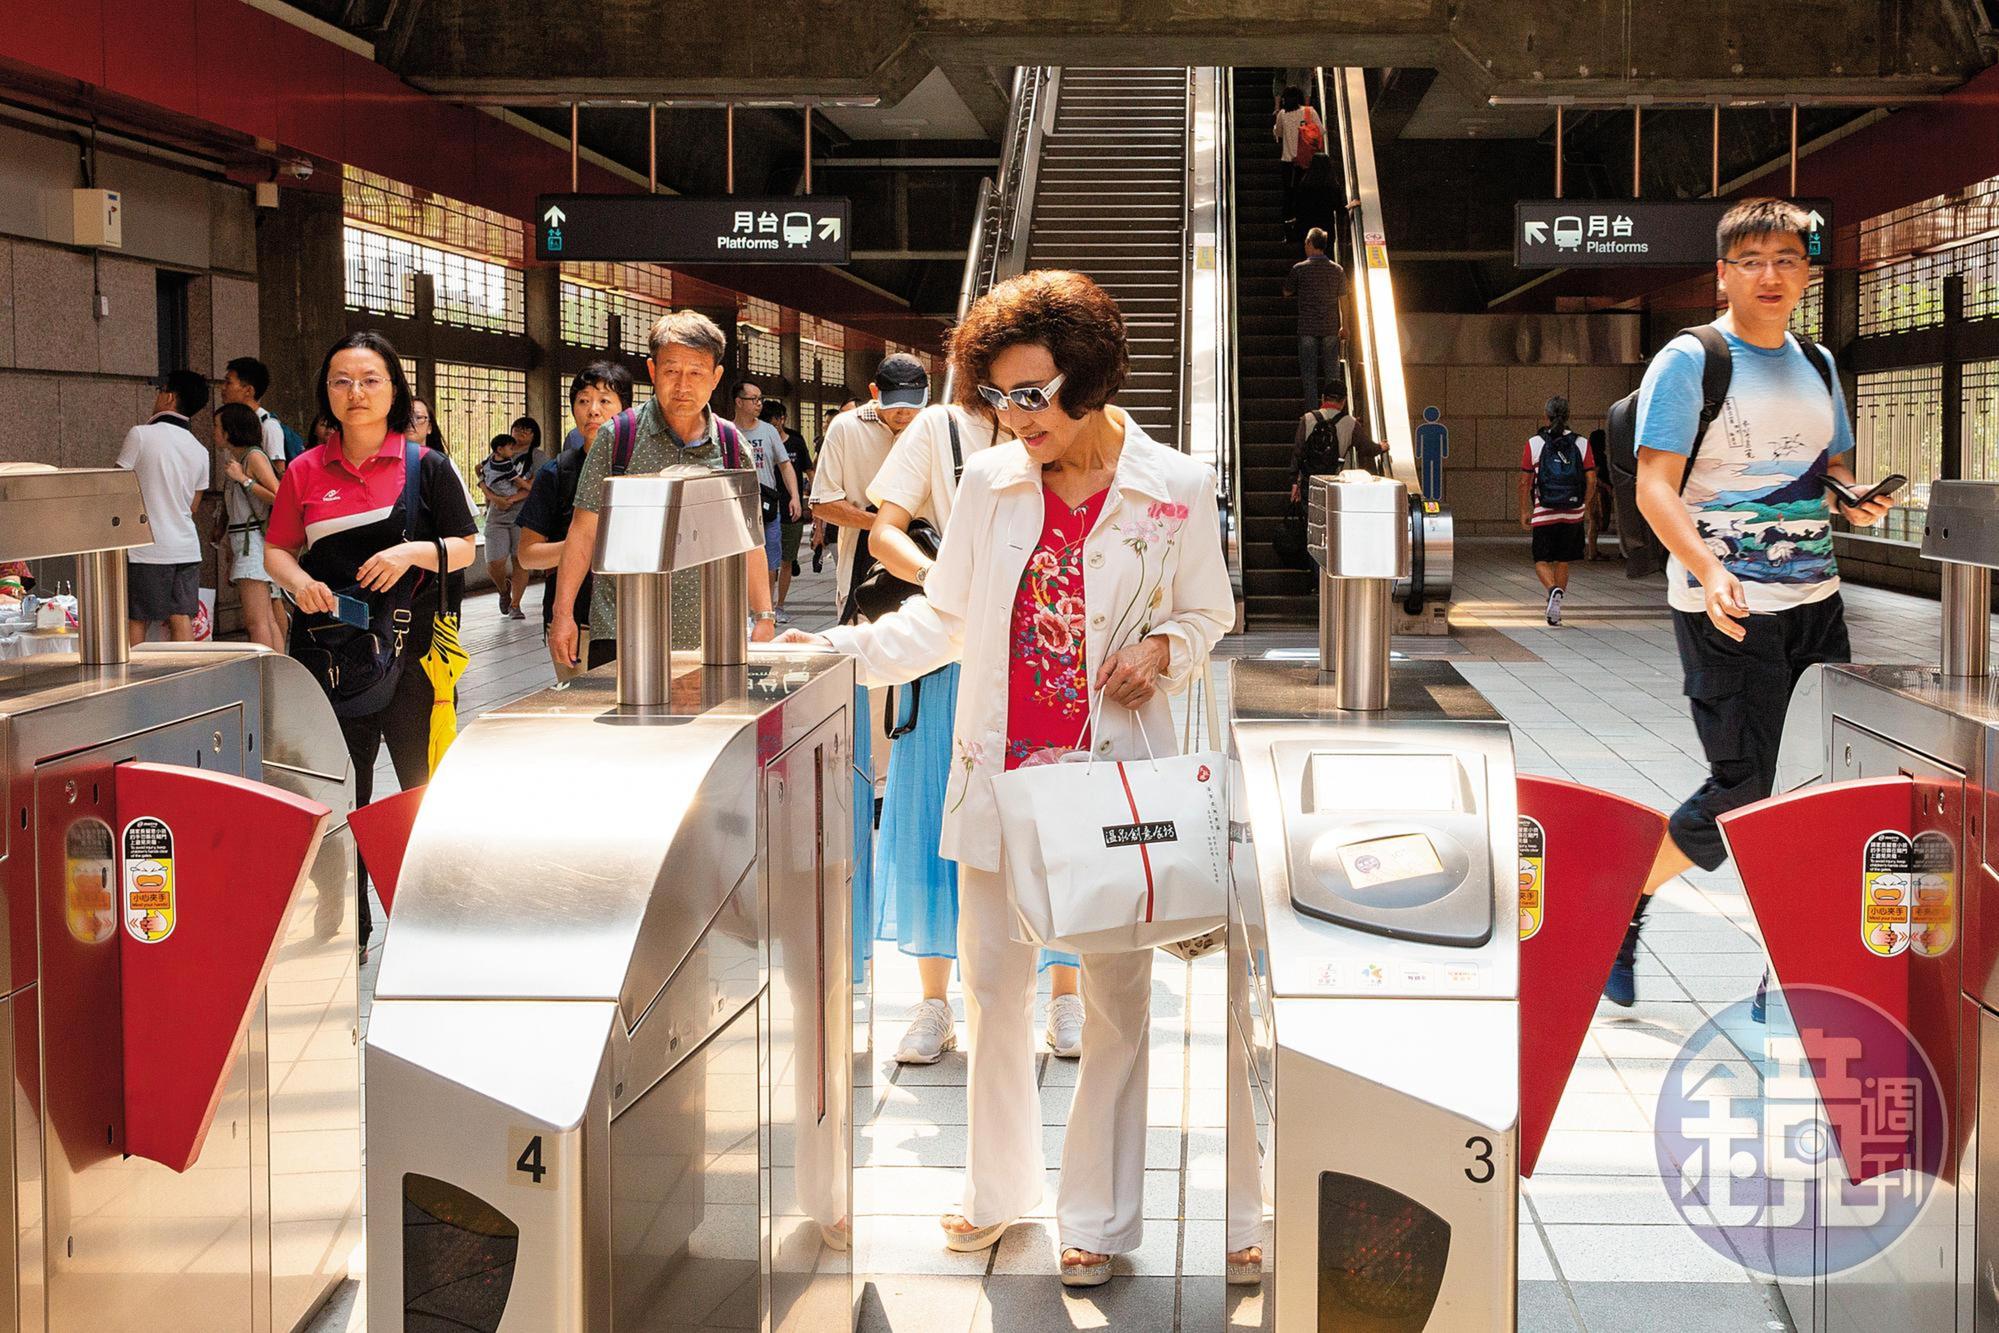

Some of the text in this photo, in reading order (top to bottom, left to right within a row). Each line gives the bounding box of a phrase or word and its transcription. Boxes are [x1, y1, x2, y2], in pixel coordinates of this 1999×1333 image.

[732, 210, 779, 234] 月台
[1586, 214, 1634, 238] 月台
[717, 236, 779, 249] Platforms
[1586, 240, 1649, 253] Platforms
[516, 1135, 546, 1184] 4
[1464, 1135, 1496, 1184] 3
